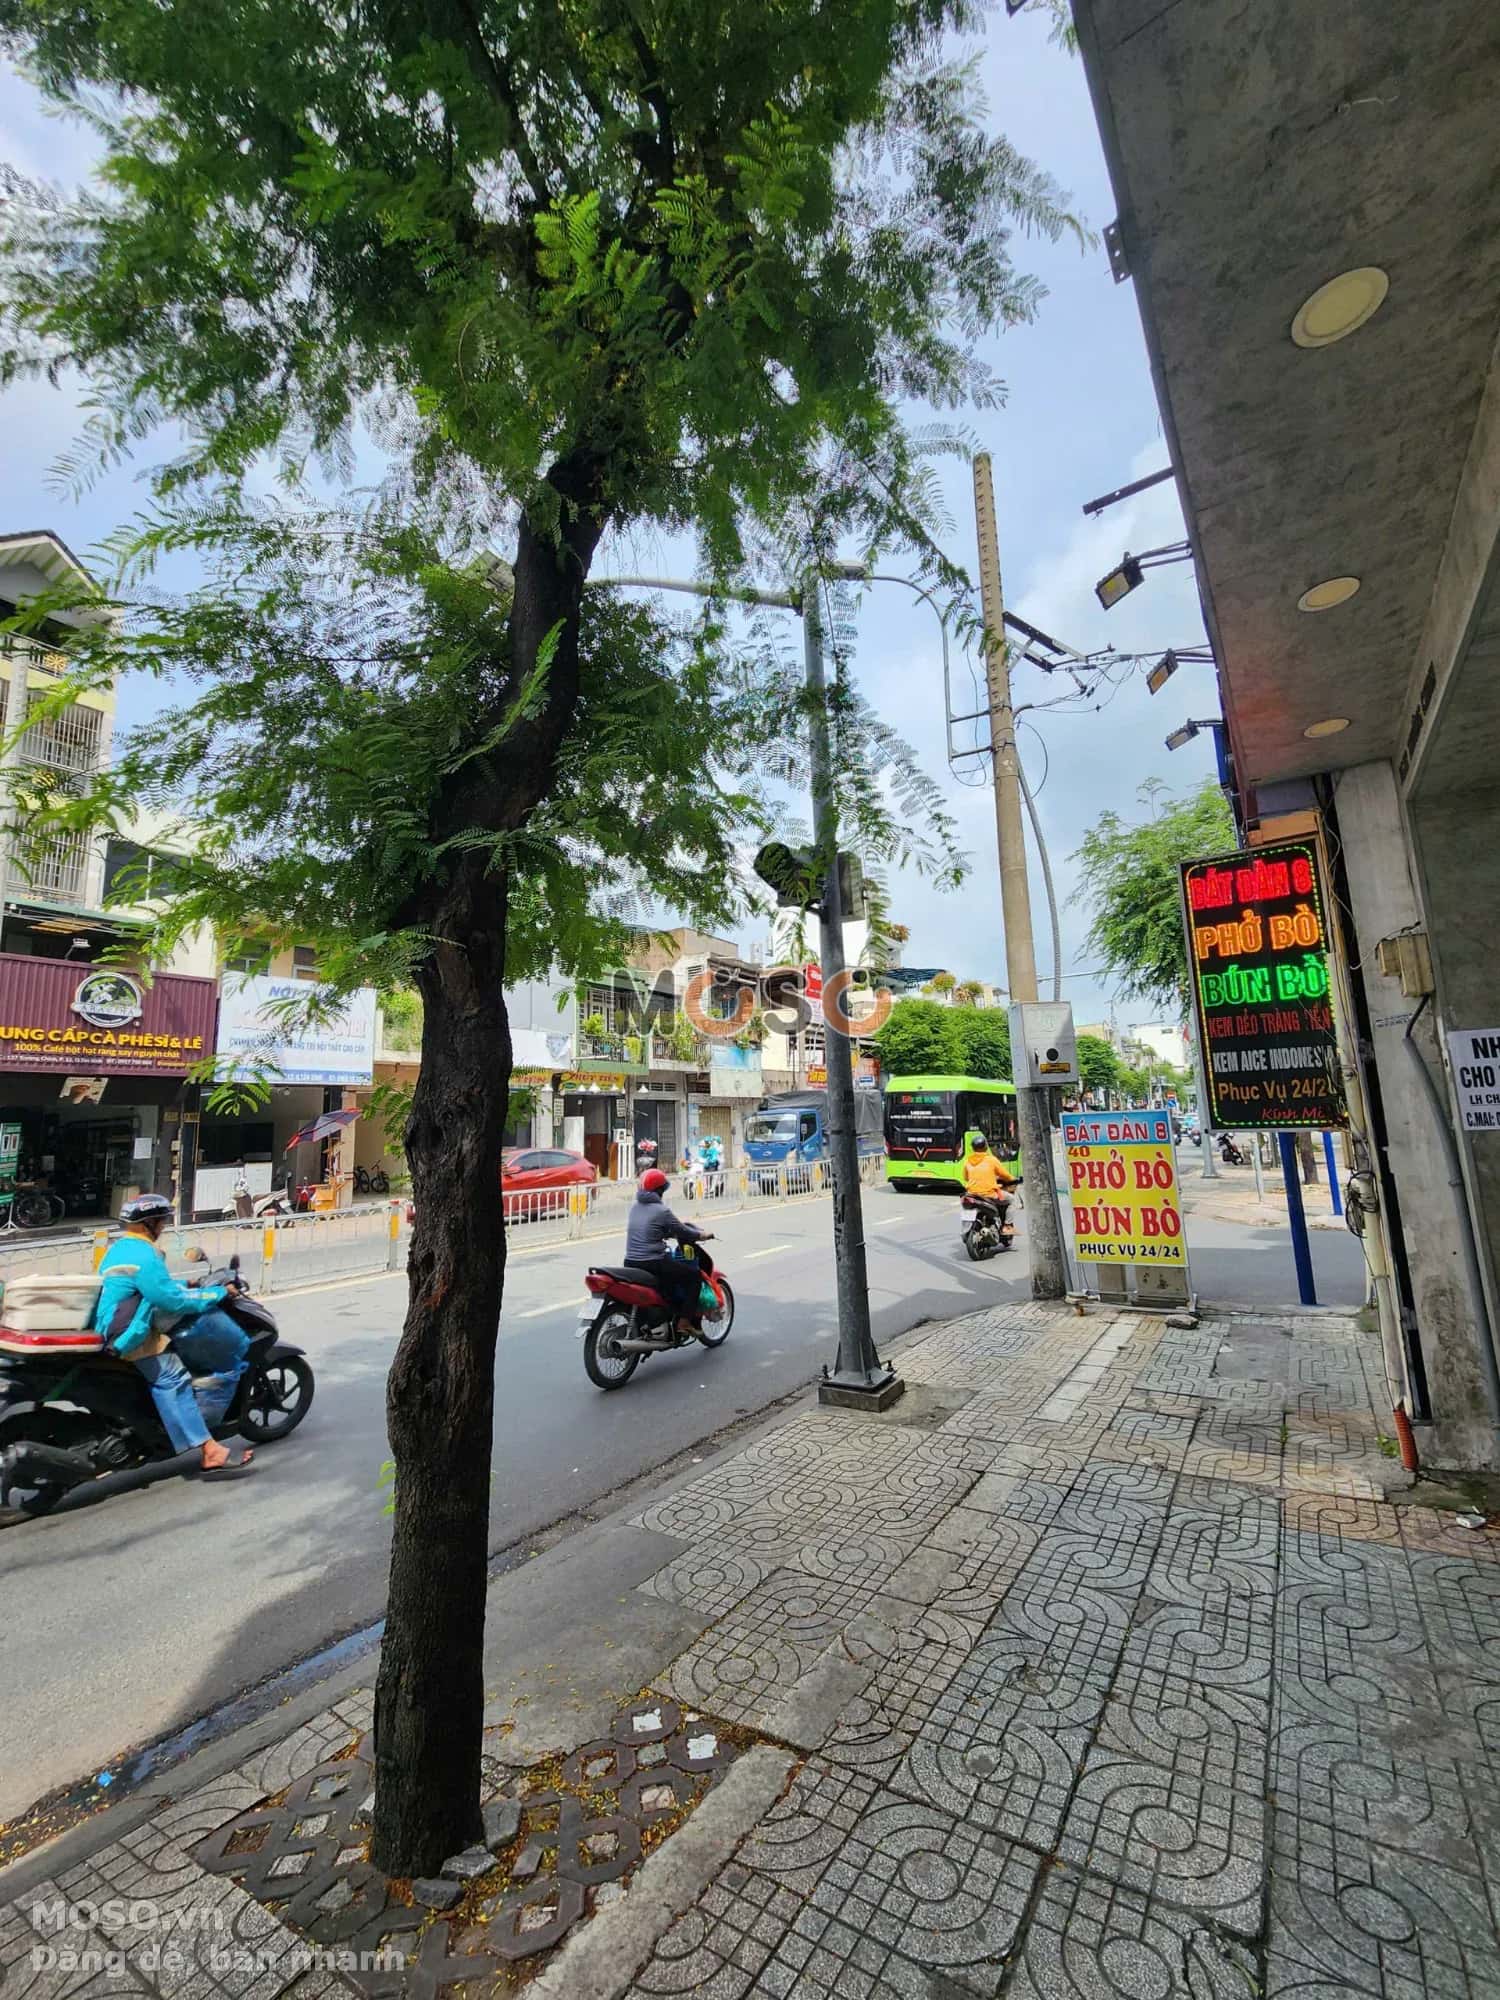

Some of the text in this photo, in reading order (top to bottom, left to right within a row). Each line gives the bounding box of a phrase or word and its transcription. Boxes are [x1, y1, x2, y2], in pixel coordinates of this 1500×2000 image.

[1190, 867, 1233, 910] BÁT
[1292, 857, 1312, 894] 8
[1196, 903, 1319, 959] PHỞ BÒ
[1201, 952, 1327, 1007] BÚN BÒ
[48, 1025, 89, 1042] CẤP
[90, 1030, 116, 1044] CÀ
[118, 1033, 153, 1047] PHÊ
[169, 1037, 181, 1048] &
[1208, 1017, 1233, 1038] KEM
[15, 1042, 41, 1052] 100%
[1212, 1051, 1238, 1073] KEM
[1241, 1049, 1267, 1072] AICE
[1460, 1066, 1495, 1088] CHO
[1218, 1077, 1334, 1104] Phục Vụ 24/2
[1065, 1118, 1168, 1142] BÁT ĐÀN 8
[1070, 1149, 1173, 1190] PHỞ BÒ
[1073, 1198, 1181, 1237] BÚN BÒ
[1080, 1243, 1180, 1260] PHỤC VỤ 24/24
